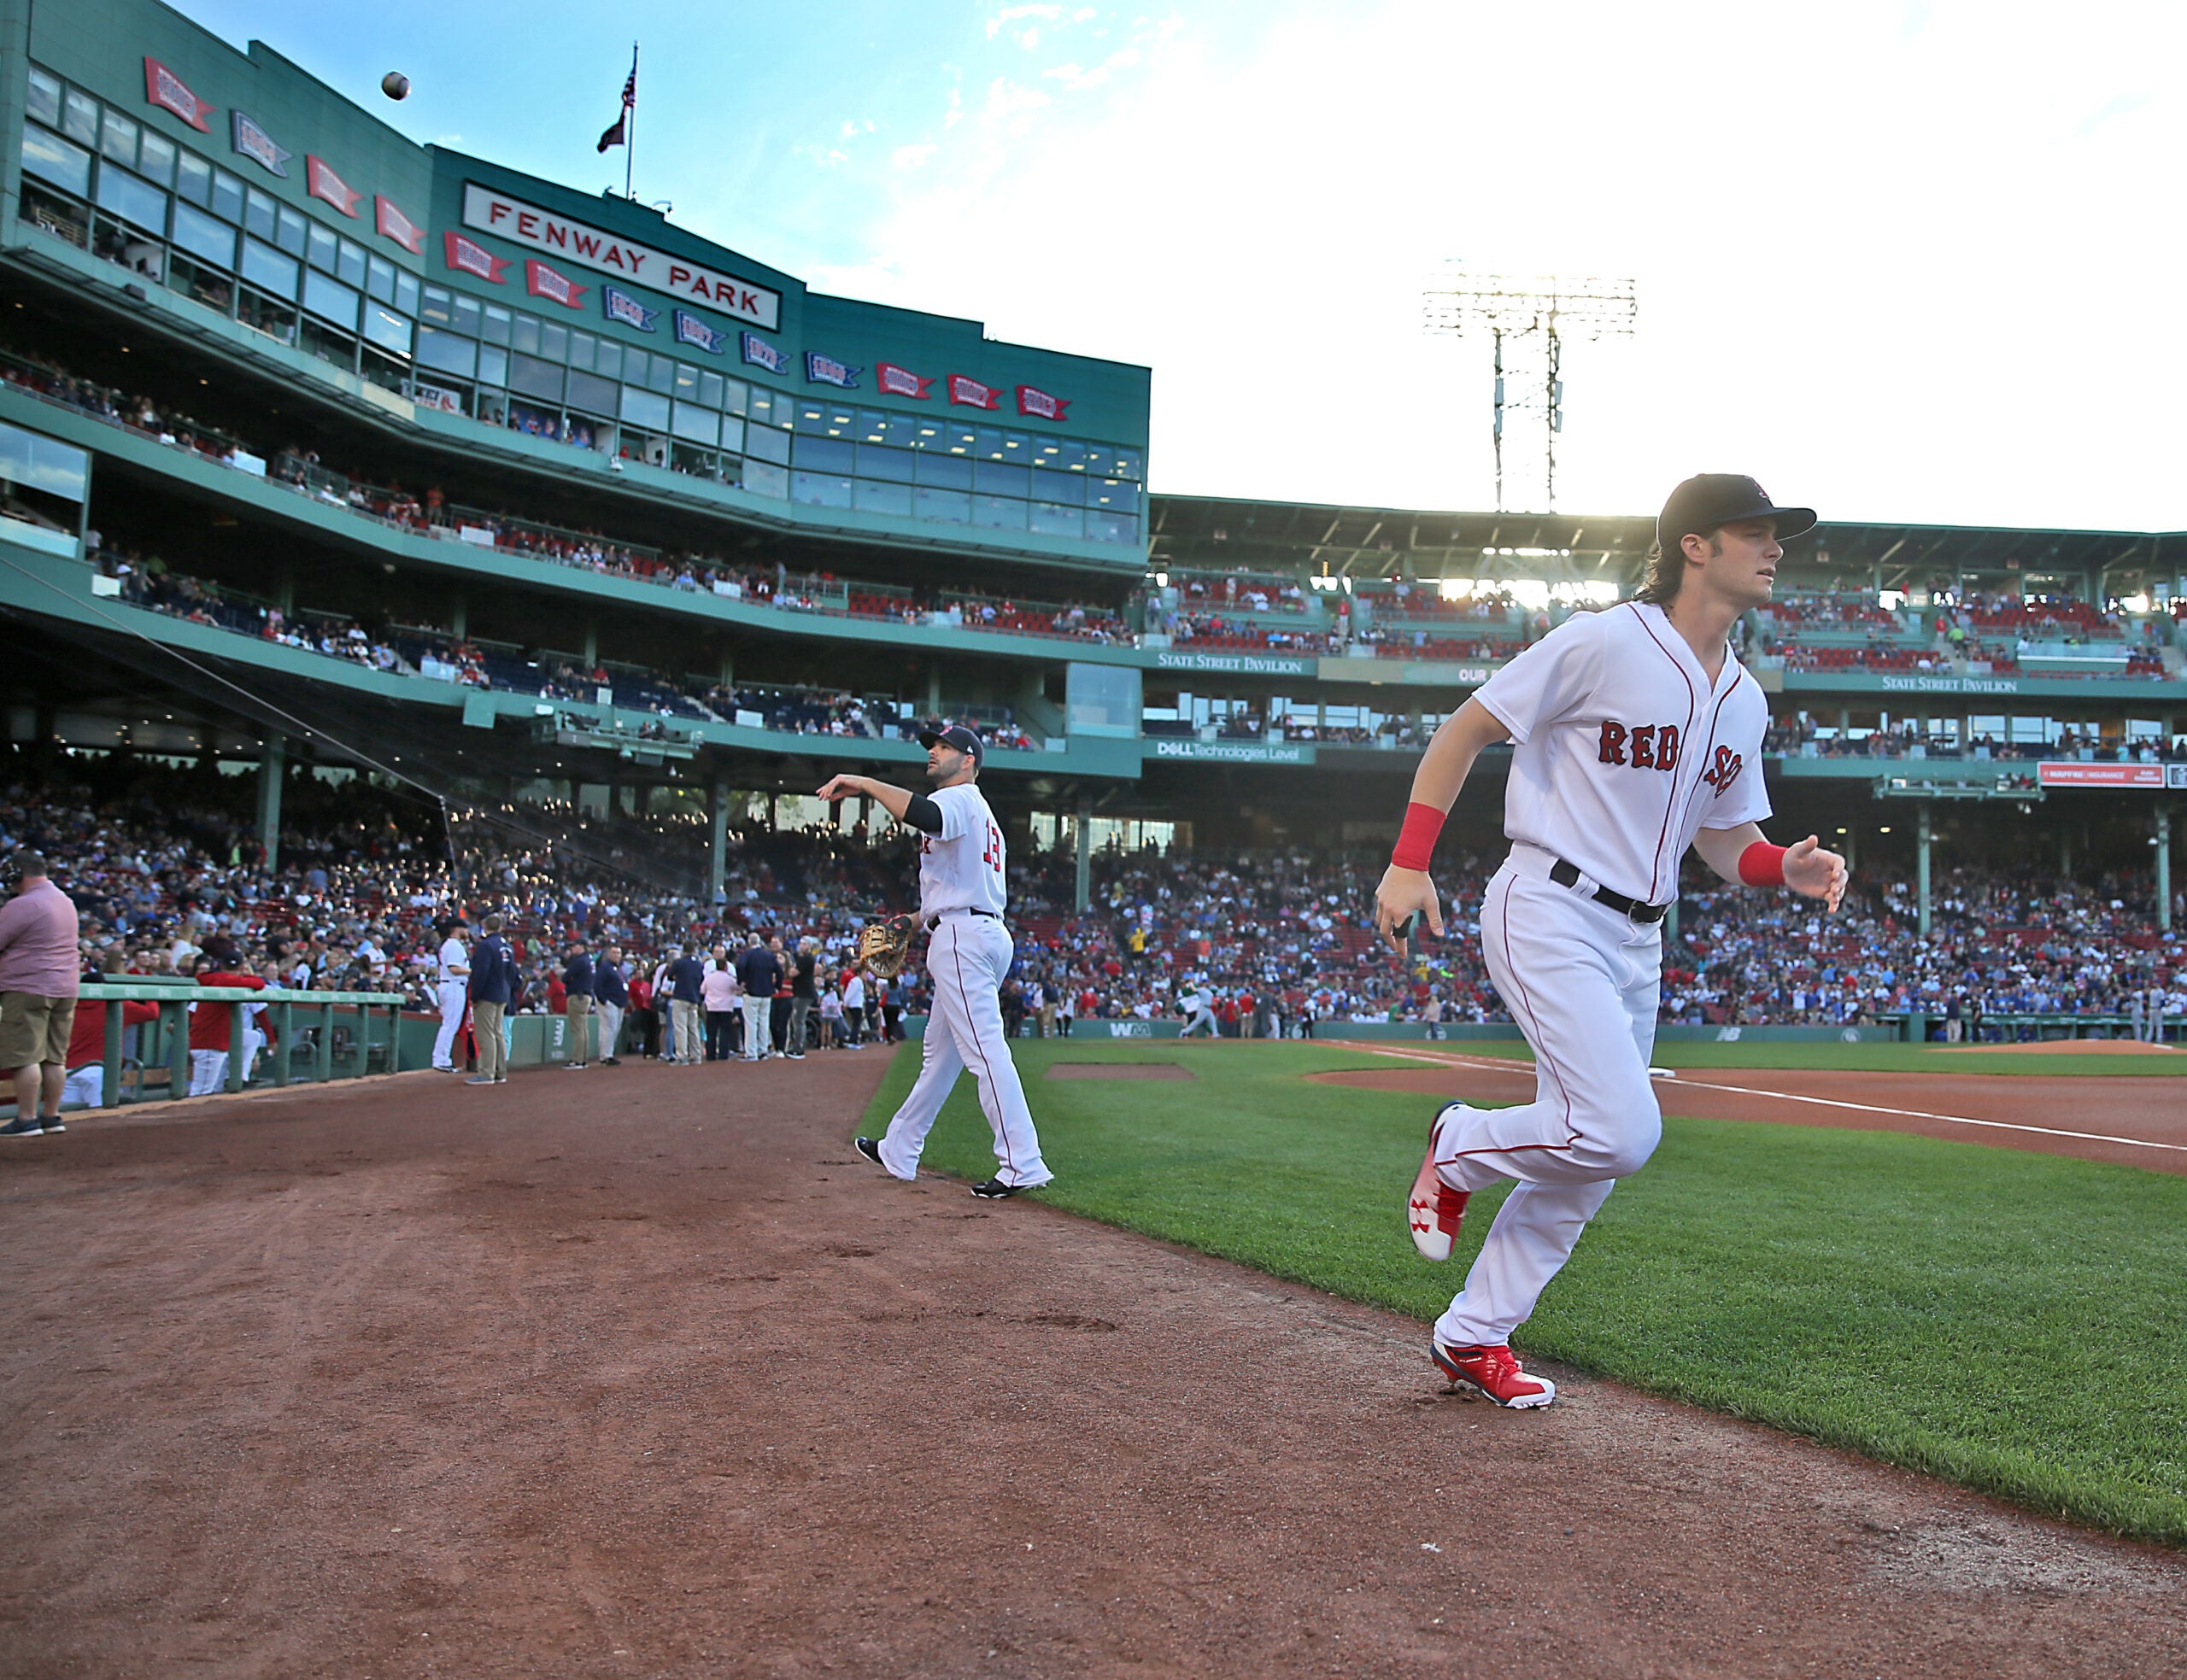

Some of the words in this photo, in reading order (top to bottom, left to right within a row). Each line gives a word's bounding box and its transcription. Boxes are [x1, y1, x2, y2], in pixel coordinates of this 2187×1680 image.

[490, 202, 646, 272] FENWAY
[670, 265, 759, 315] PARK
[1158, 653, 1195, 668] STATE
[1197, 654, 1241, 670] STREET
[1244, 657, 1302, 673] PAVILION
[1883, 676, 1917, 690] STATE
[1918, 676, 1960, 691] STREET
[1962, 678, 2018, 693] PAVILION
[1158, 742, 1194, 756] DELL
[1194, 743, 1267, 761] Technologies
[1269, 747, 1299, 760] Level
[1598, 720, 1679, 771] RED
[1703, 745, 1742, 799] SO
[983, 817, 1000, 872] 13
